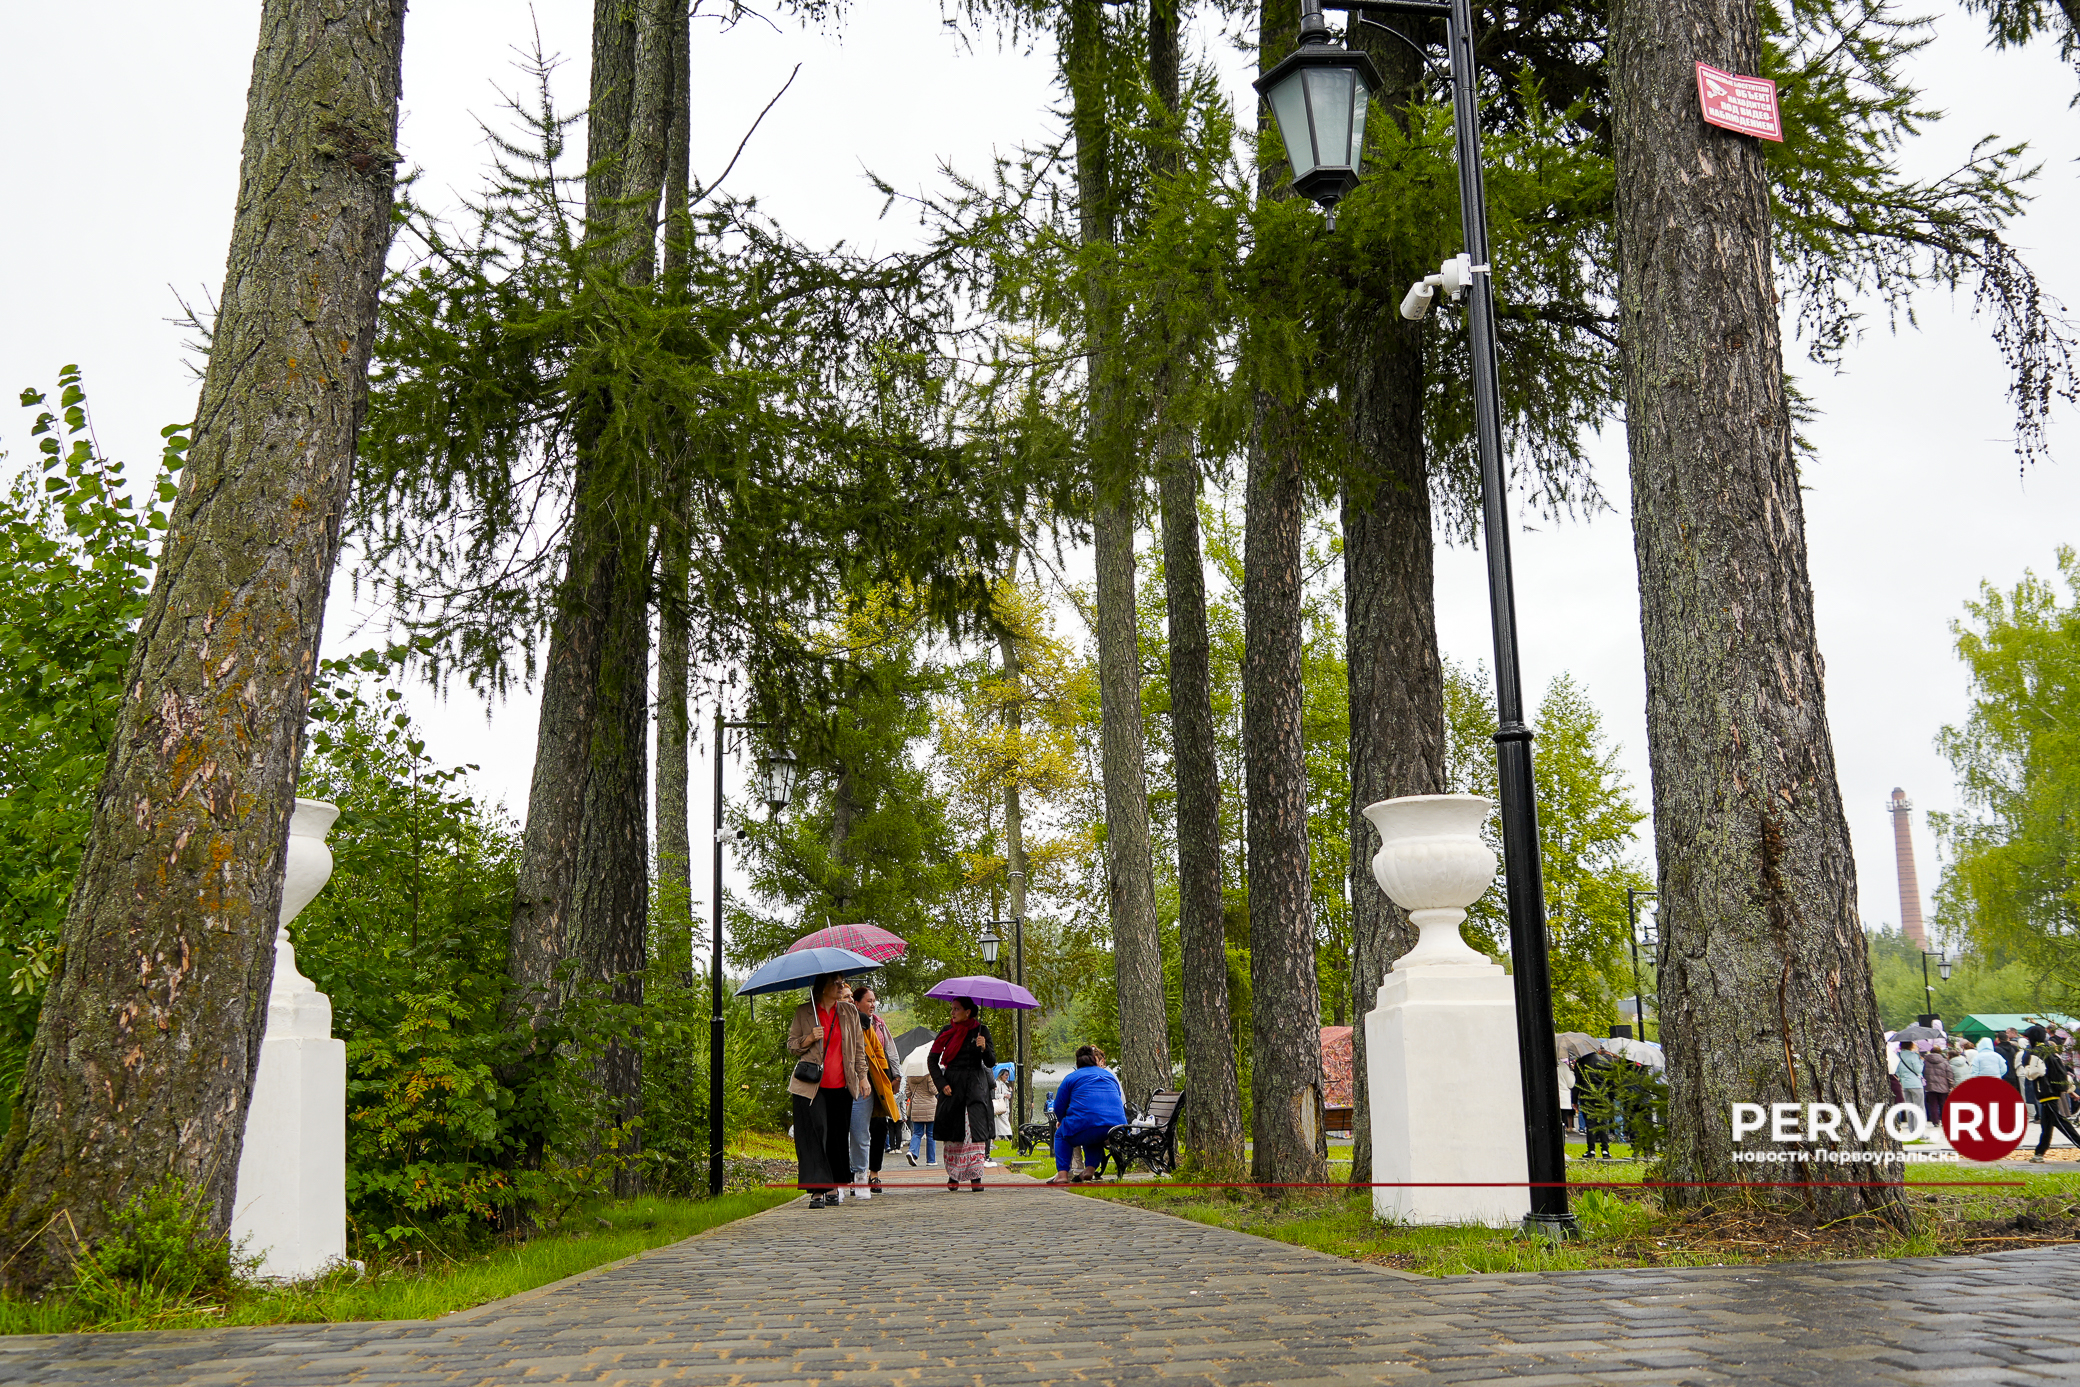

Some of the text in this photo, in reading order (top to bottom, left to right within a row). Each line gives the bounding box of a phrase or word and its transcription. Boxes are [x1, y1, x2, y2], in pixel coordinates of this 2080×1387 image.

[1727, 95, 1772, 111] НАХОДИТСЯ
[1735, 89, 1770, 103] ОБЪЕКТ
[1708, 107, 1775, 132] НАБЛЮДЕНИЕМ
[1721, 101, 1774, 121] ПОД ВИДЕО-
